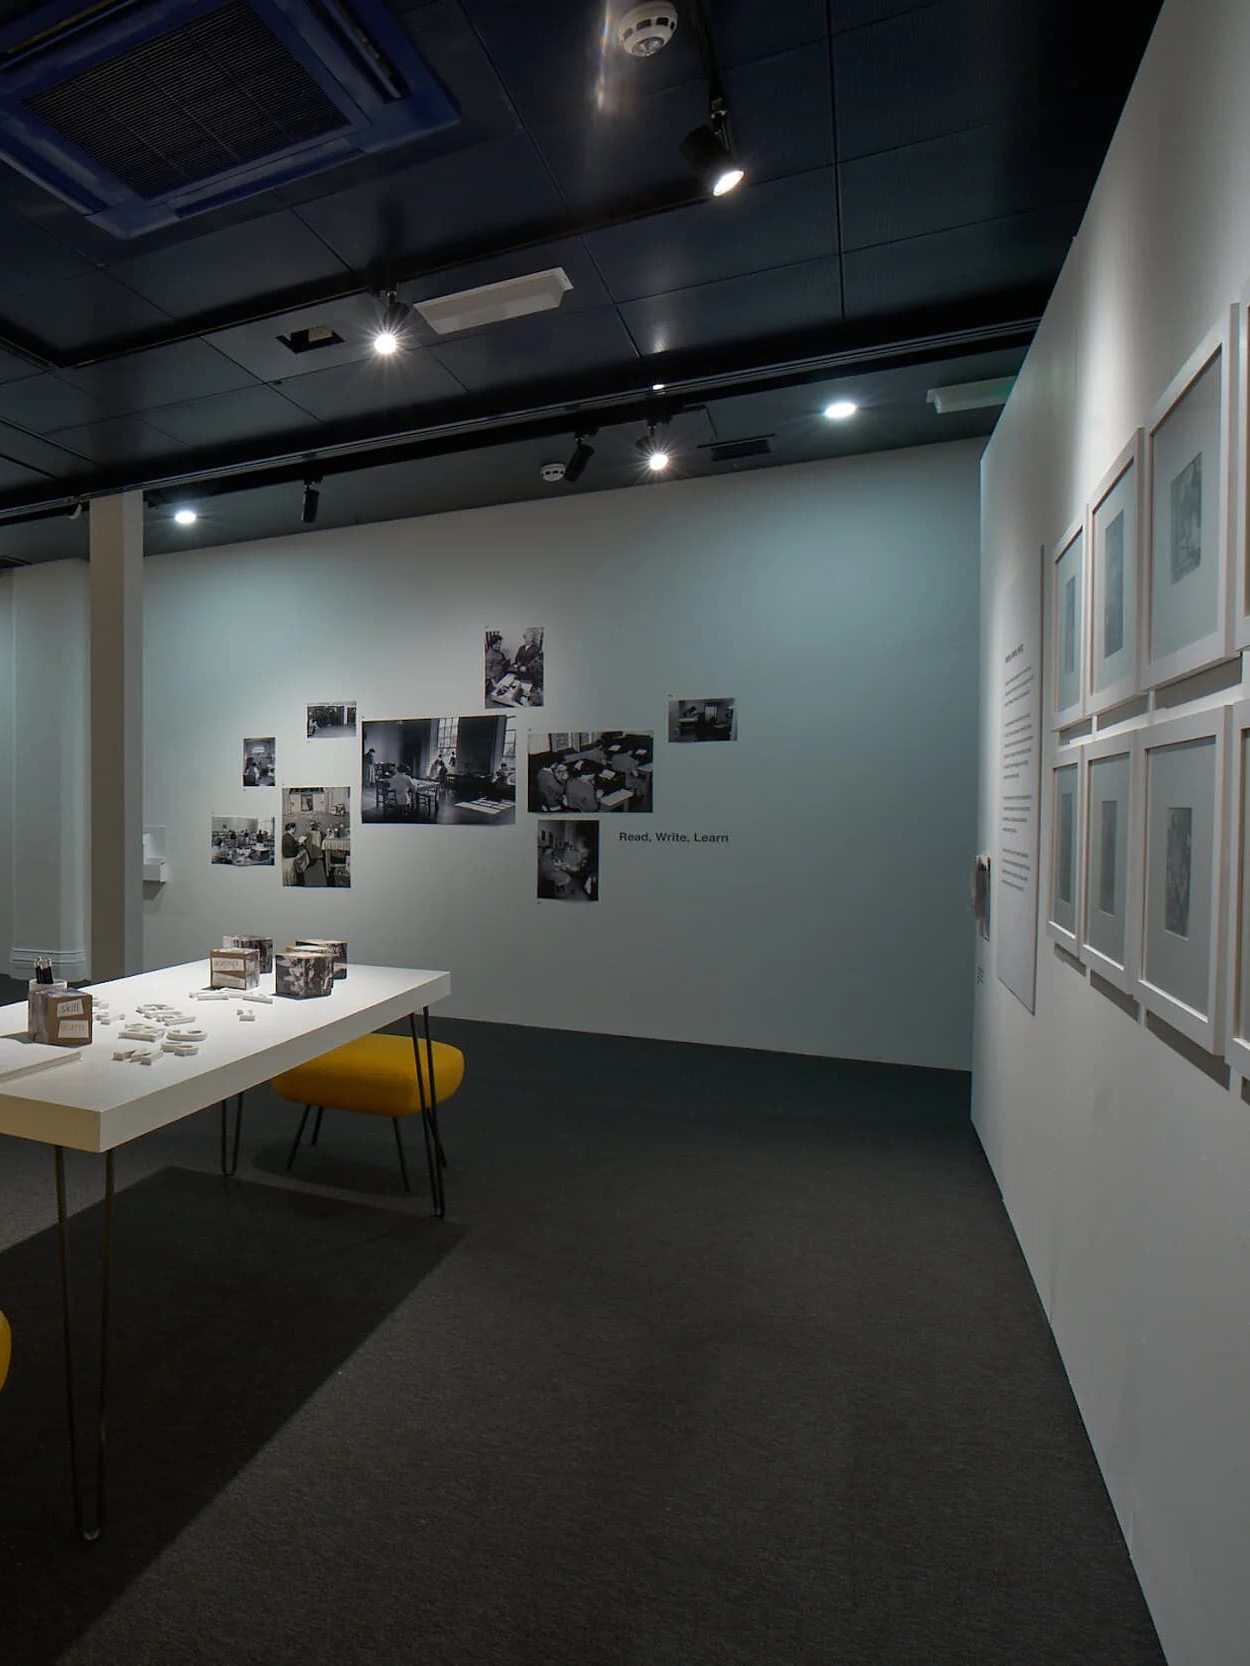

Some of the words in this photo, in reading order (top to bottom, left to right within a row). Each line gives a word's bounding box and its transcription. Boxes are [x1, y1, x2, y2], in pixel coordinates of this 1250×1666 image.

[618, 831, 652, 843] Read,
[655, 831, 691, 844] Write,
[693, 831, 729, 844] Learn
